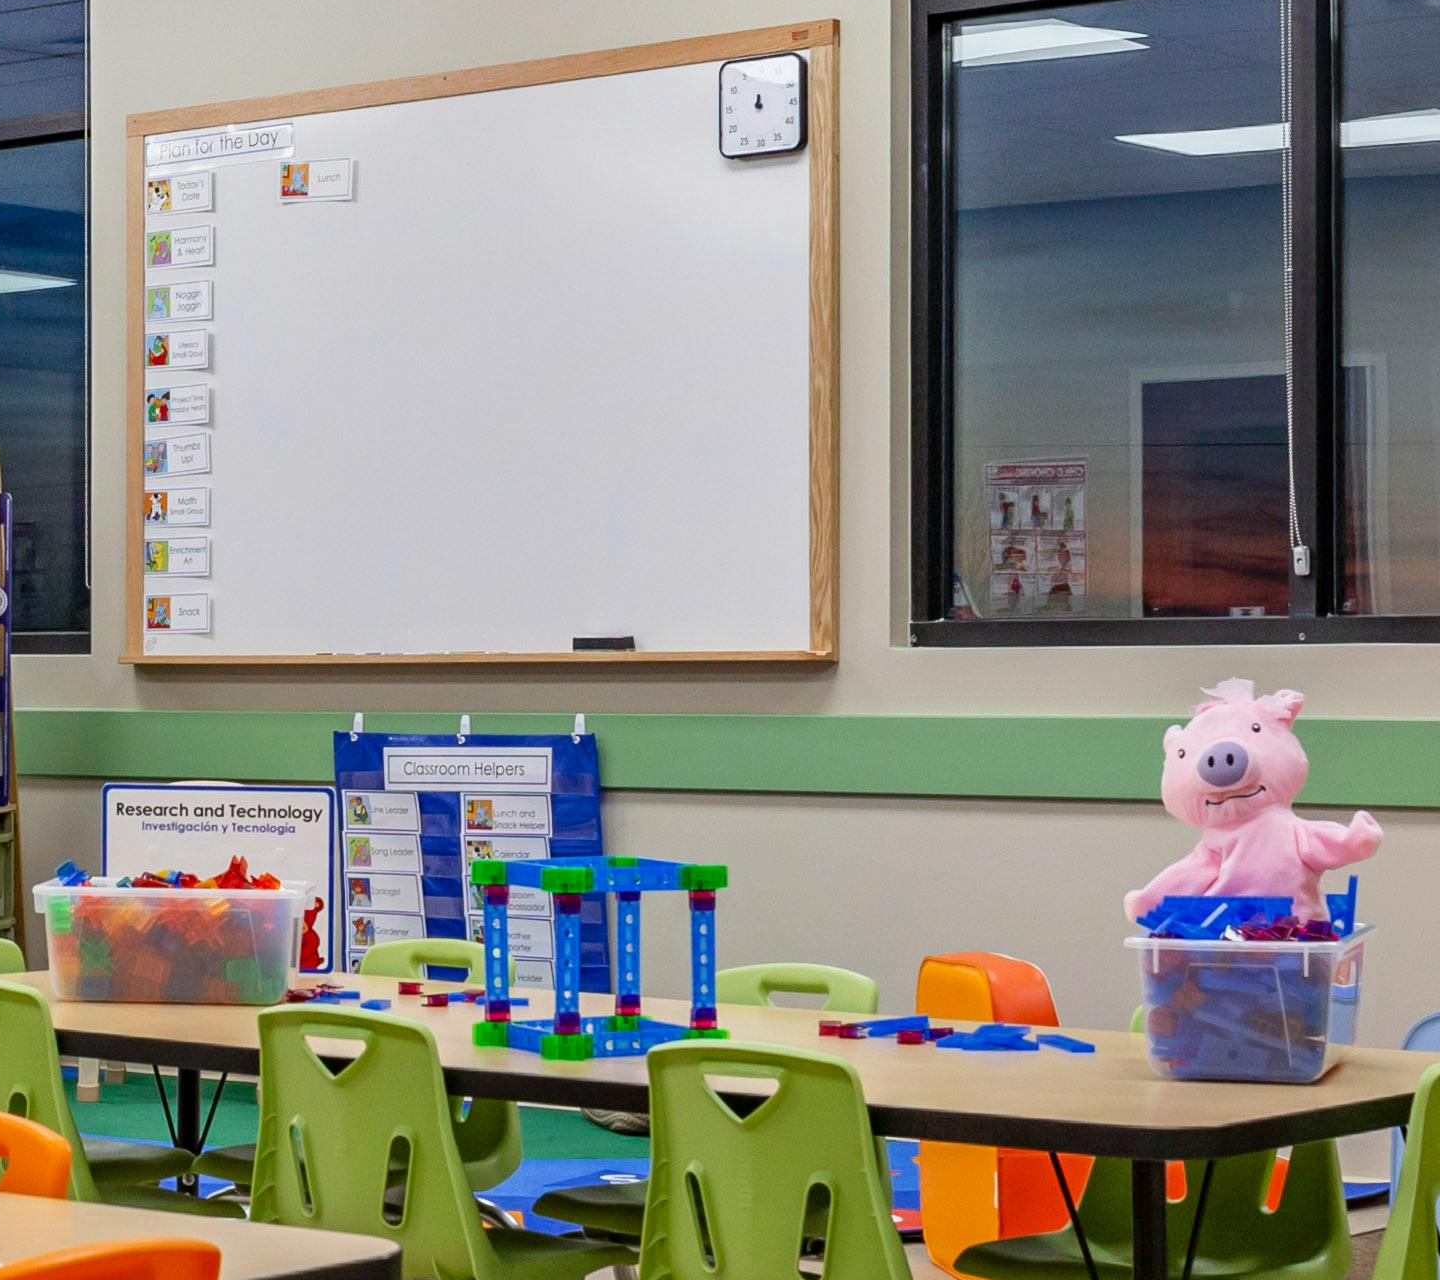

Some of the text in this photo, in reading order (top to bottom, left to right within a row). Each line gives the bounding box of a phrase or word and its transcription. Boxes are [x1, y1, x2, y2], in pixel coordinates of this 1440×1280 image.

[789, 97, 797, 105] 45
[726, 106, 733, 114] 15
[729, 125, 737, 133] 20
[740, 137, 748, 145] 25
[773, 133, 781, 141] 35
[159, 131, 279, 160] Plan for the Day
[757, 139, 765, 147] 30
[317, 173, 341, 183] Lunch
[182, 192, 200, 201] Date
[173, 442, 200, 452] Thumbs
[178, 496, 197, 505] Math
[178, 607, 200, 616] Snack
[403, 760, 525, 778] Classroom Helpers
[116, 802, 323, 822] Research and Technology
[494, 809, 535, 817] Lunch and
[141, 820, 296, 835] Investigación y Tecnología
[520, 821, 545, 830] Helper
[375, 926, 410, 935] Gardener
[517, 974, 543, 982] Holder
